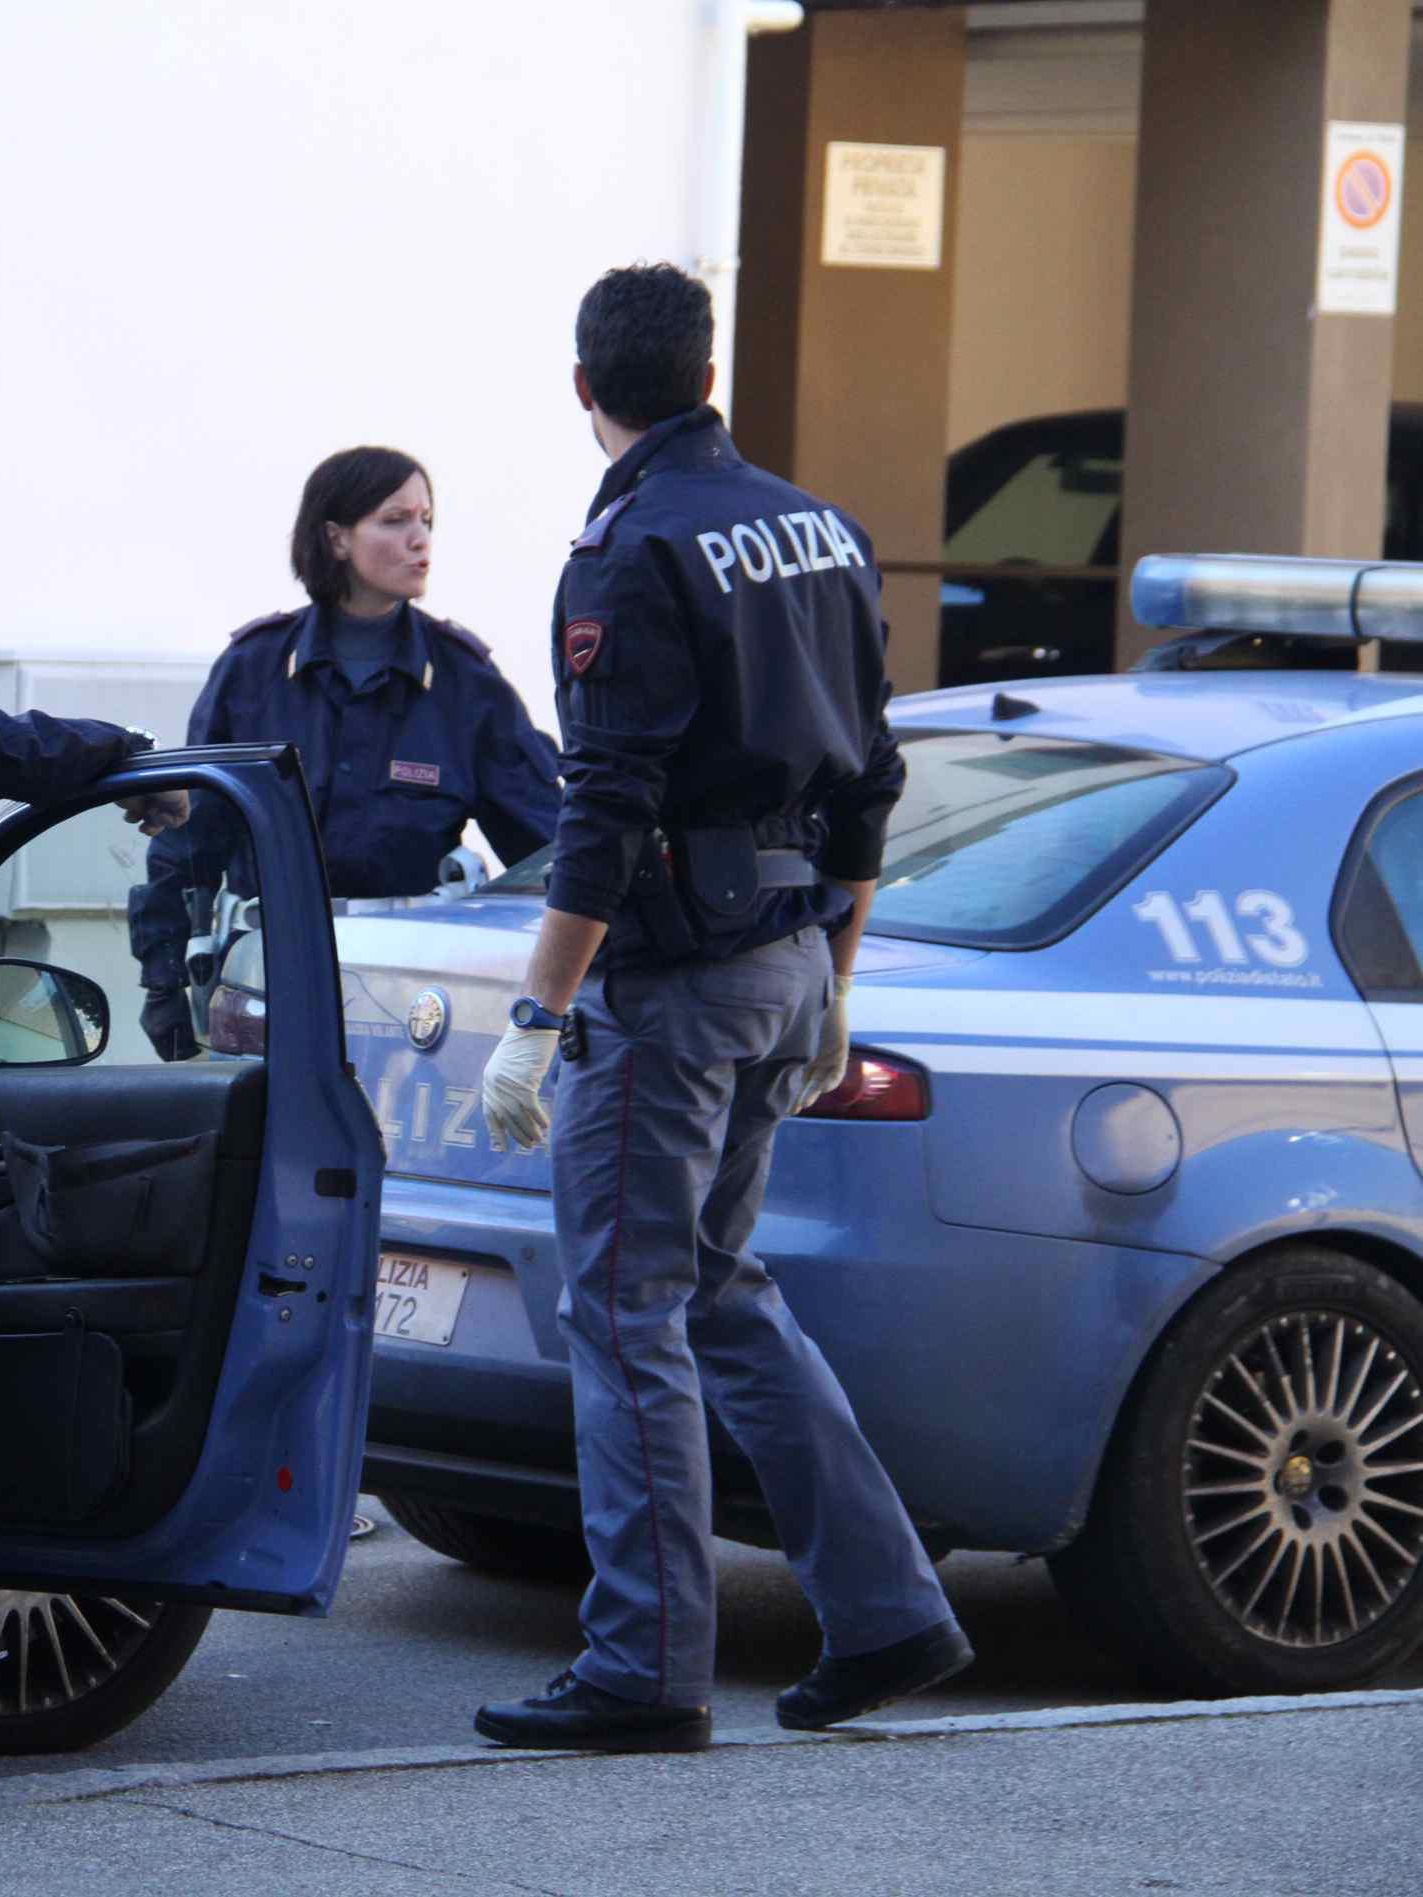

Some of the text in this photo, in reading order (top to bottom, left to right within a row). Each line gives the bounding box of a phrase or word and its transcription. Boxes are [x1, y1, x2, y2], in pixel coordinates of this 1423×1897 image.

[696, 509, 866, 594] POLIZIA
[392, 764, 436, 781] POLIZIA
[1131, 888, 1308, 968] 113
[377, 1077, 553, 1158] LIZ
[377, 1257, 429, 1290] LIZIA
